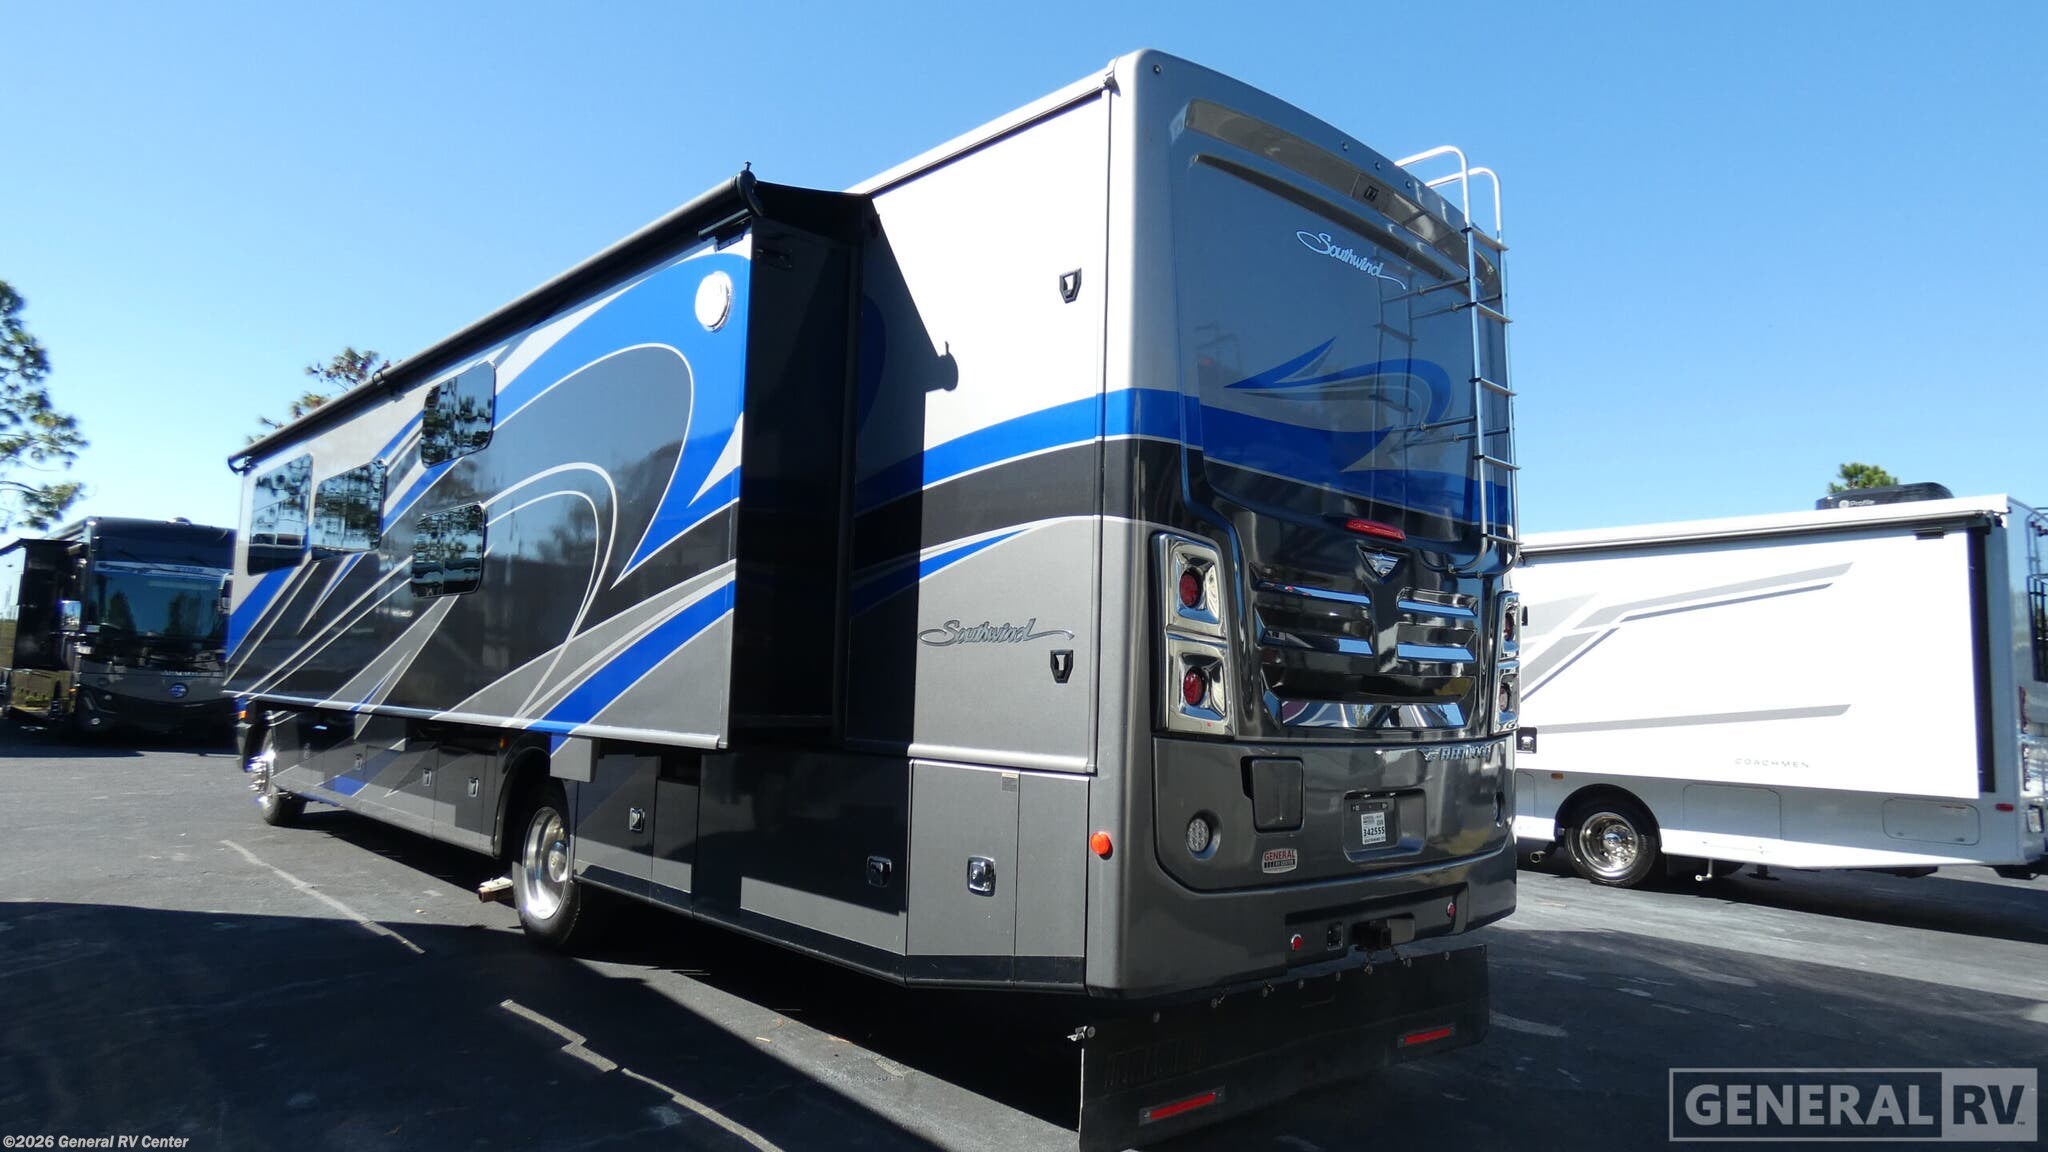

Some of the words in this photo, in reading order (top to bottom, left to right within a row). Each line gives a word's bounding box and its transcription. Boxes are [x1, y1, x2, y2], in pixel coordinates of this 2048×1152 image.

[1296, 230, 1407, 290] Southwind
[918, 617, 1075, 647] Southwind
[1735, 758, 1809, 769] COACHMEN
[1363, 826, 1385, 837] 342555
[1264, 850, 1296, 861] GENERAL
